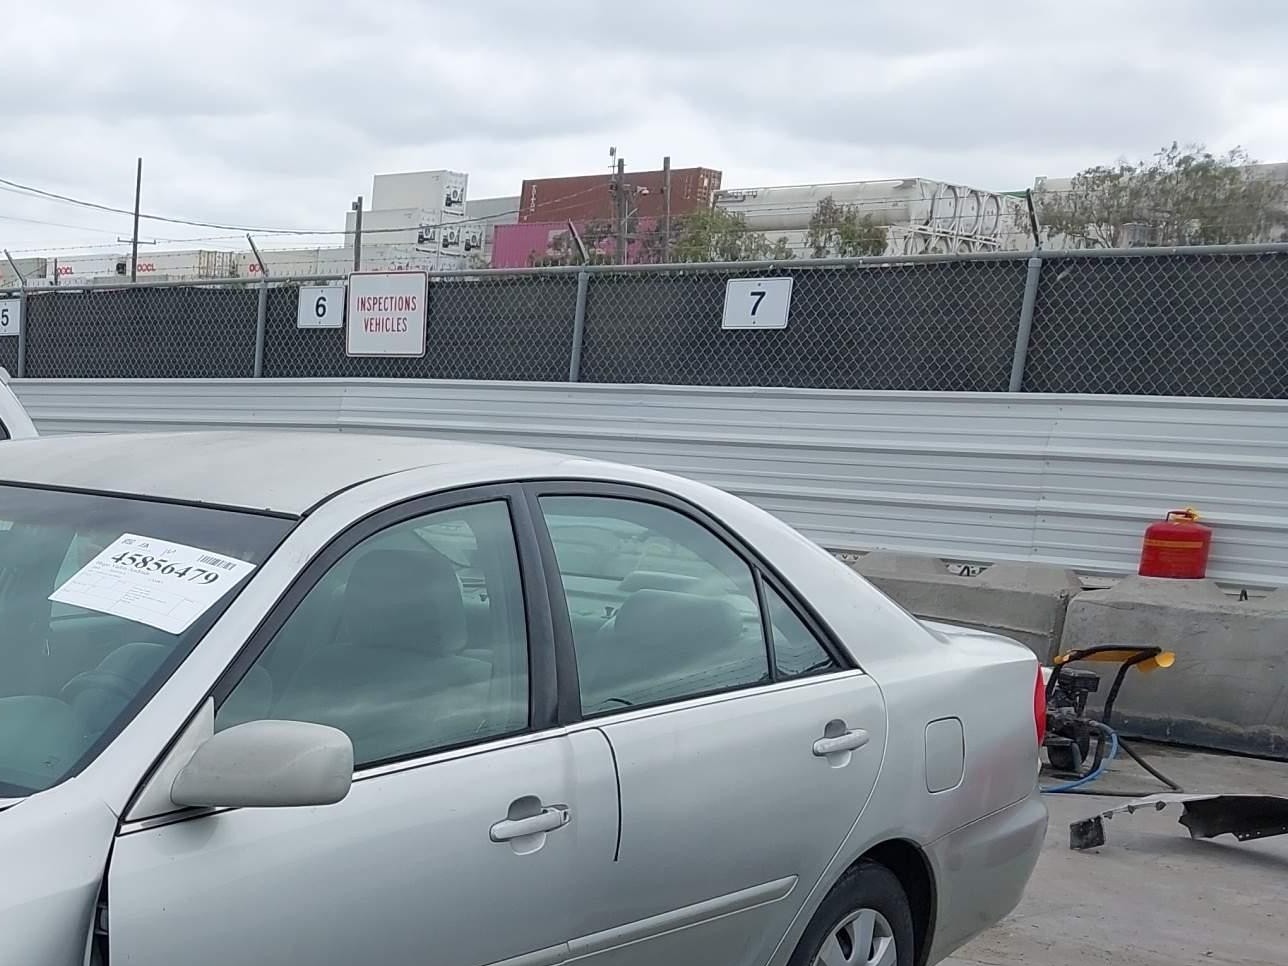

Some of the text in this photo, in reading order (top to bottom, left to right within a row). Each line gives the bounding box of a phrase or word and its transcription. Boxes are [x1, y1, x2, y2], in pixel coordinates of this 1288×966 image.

[315, 296, 327, 318] 6
[357, 295, 417, 312] INSPECTIONS
[750, 291, 766, 316] 7
[0, 308, 10, 327] 5
[364, 317, 408, 333] VEHICLES
[111, 551, 219, 585] 45856479
